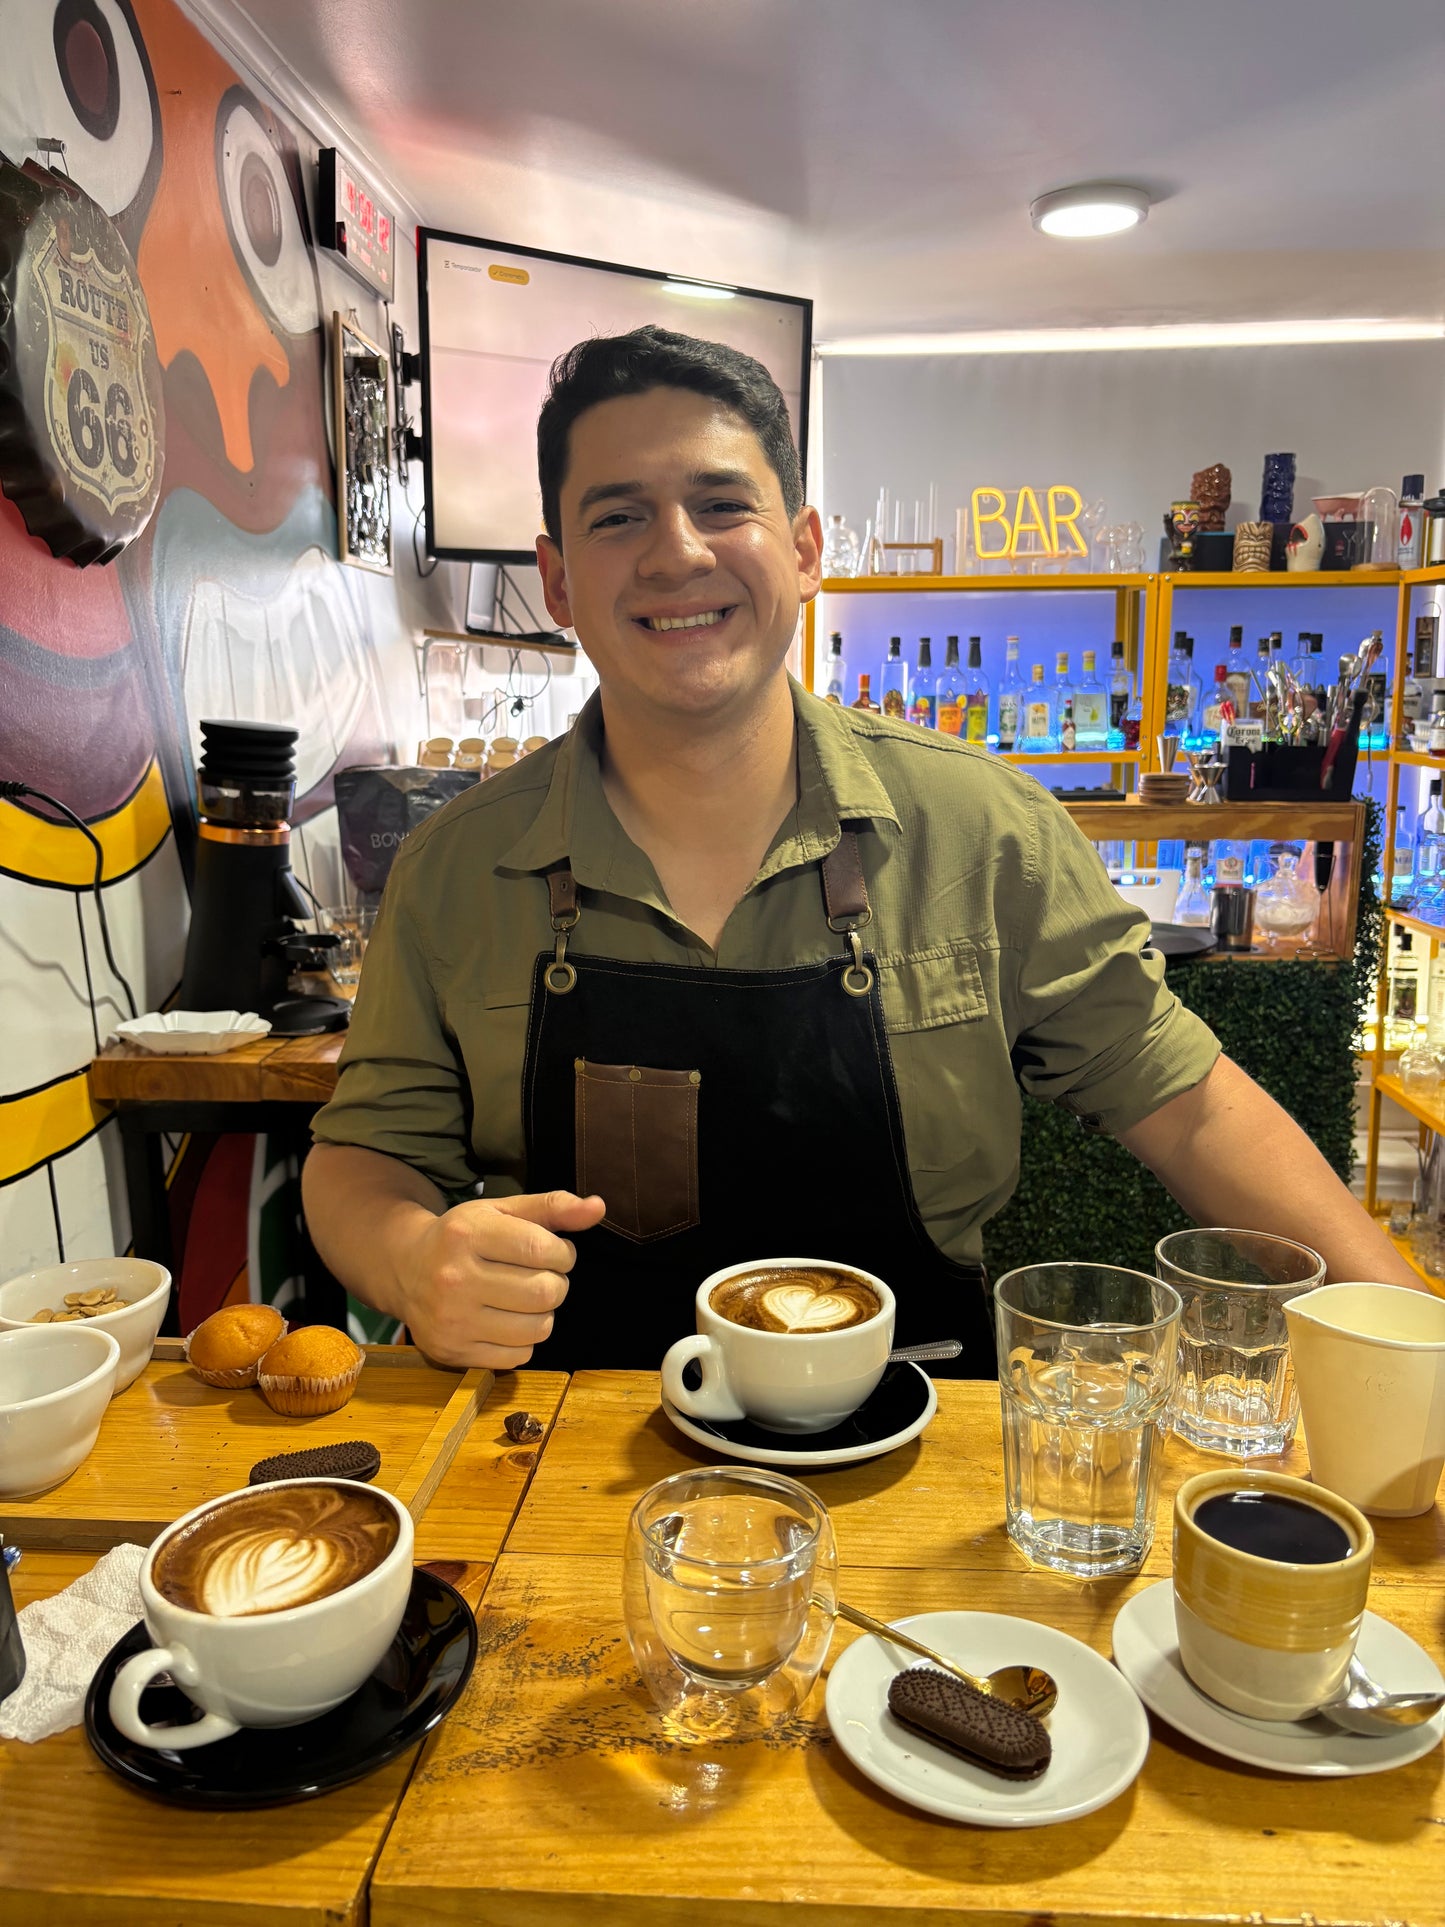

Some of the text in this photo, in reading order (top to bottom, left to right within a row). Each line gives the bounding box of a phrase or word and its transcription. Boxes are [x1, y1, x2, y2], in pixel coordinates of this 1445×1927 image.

[58, 268, 129, 332] ROUTE
[88, 338, 109, 370] US
[67, 367, 138, 478] 66
[971, 485, 1089, 560] BAR
[370, 831, 410, 849] BON
